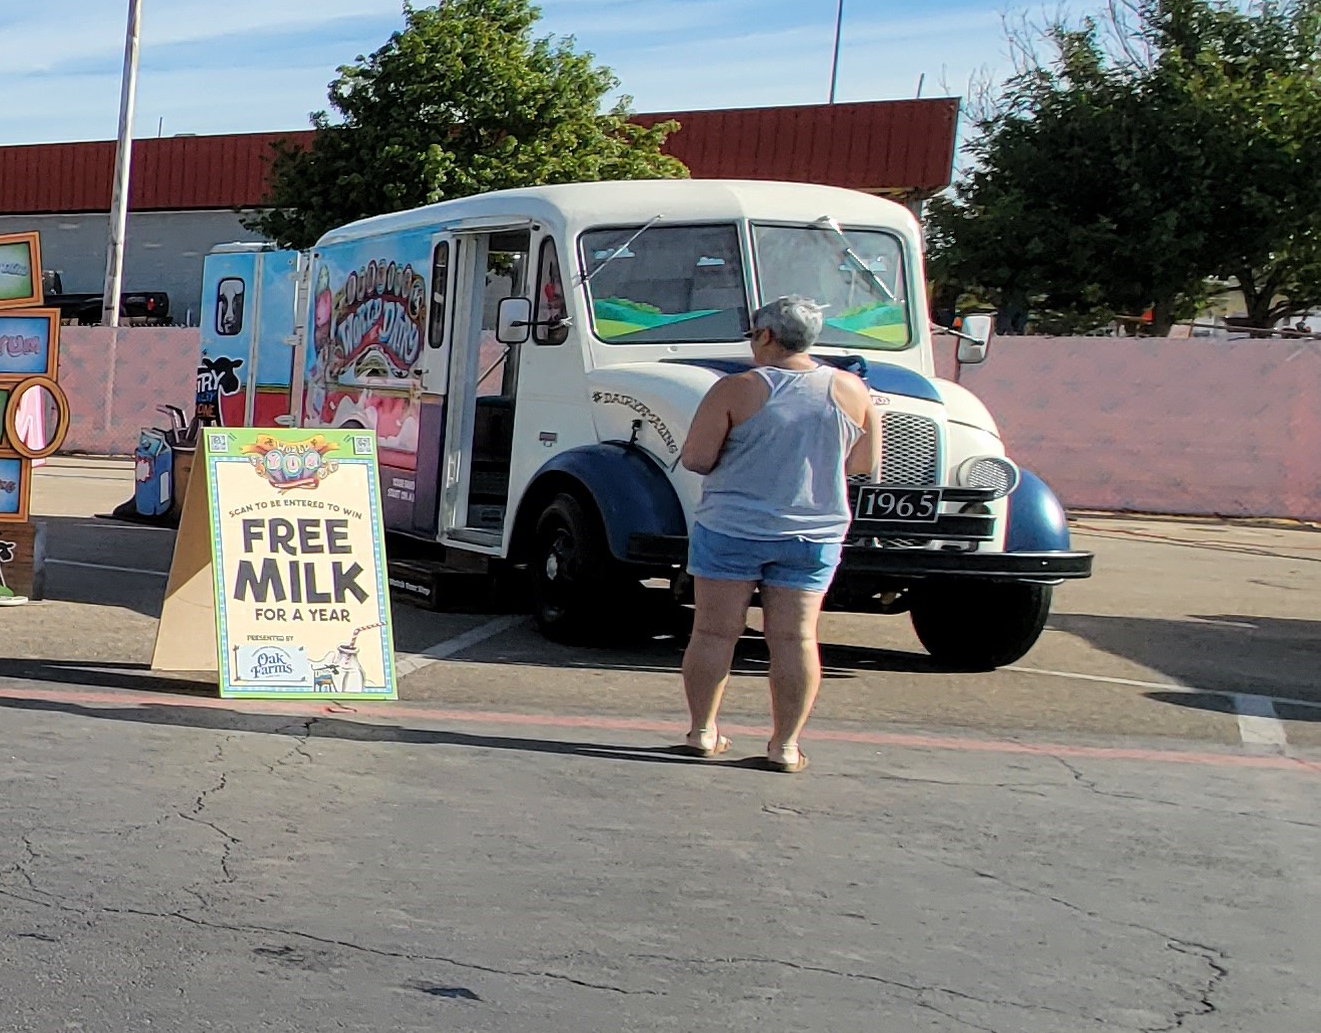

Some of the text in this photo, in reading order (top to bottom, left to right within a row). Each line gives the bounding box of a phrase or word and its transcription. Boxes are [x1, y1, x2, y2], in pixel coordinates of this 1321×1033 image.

[229, 499, 363, 520] SCAN TO BE ENTERED TO WIN
[864, 492, 934, 517] 1965
[242, 517, 352, 556] FREE
[233, 557, 370, 605] MILK
[255, 608, 351, 622] FOR A YEAR
[257, 652, 287, 668] Oak
[250, 663, 293, 679] Farms
